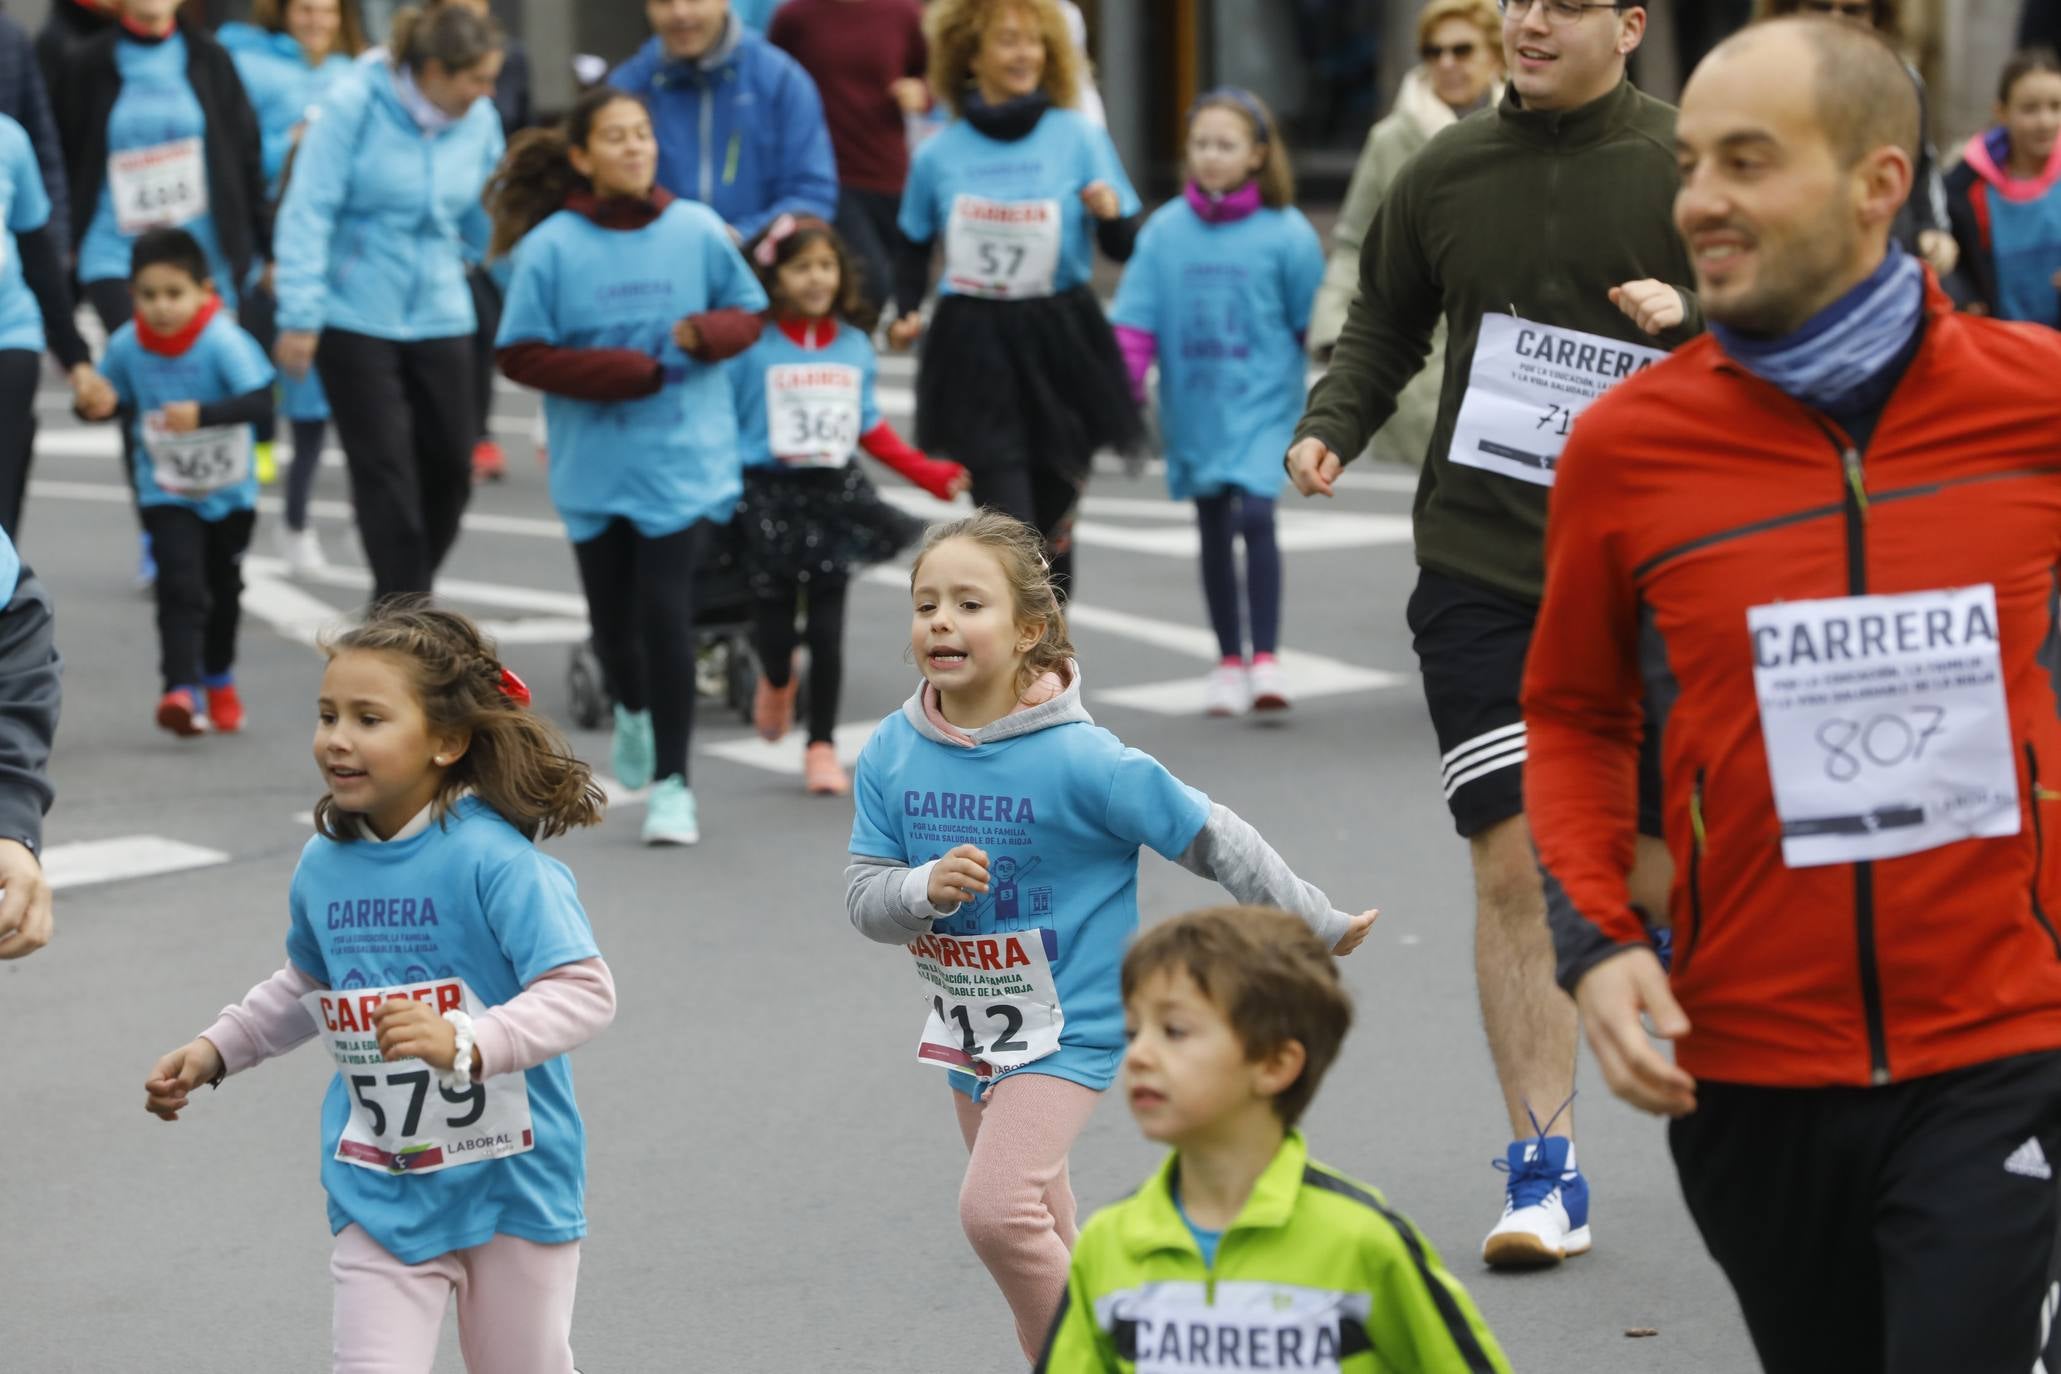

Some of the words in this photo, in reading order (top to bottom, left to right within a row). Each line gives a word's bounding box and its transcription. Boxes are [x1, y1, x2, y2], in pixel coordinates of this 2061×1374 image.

[979, 243, 1025, 277] 57
[1536, 404, 1579, 436] 71
[1754, 605, 1997, 669] CARRERA
[1814, 704, 1947, 782] 807
[904, 790, 1036, 824] CARRERA
[983, 828, 993, 836] LA
[995, 828, 1026, 836] FAMILIA
[327, 897, 439, 930] CARRERA
[974, 975, 985, 984] LA
[978, 988, 989, 997] DE
[1005, 984, 1034, 995] RIOJA
[320, 984, 461, 1032] CARR
[351, 1069, 486, 1133] 579
[447, 1133, 512, 1154] LABORAL
[1136, 1320, 1340, 1368] CARRERA
